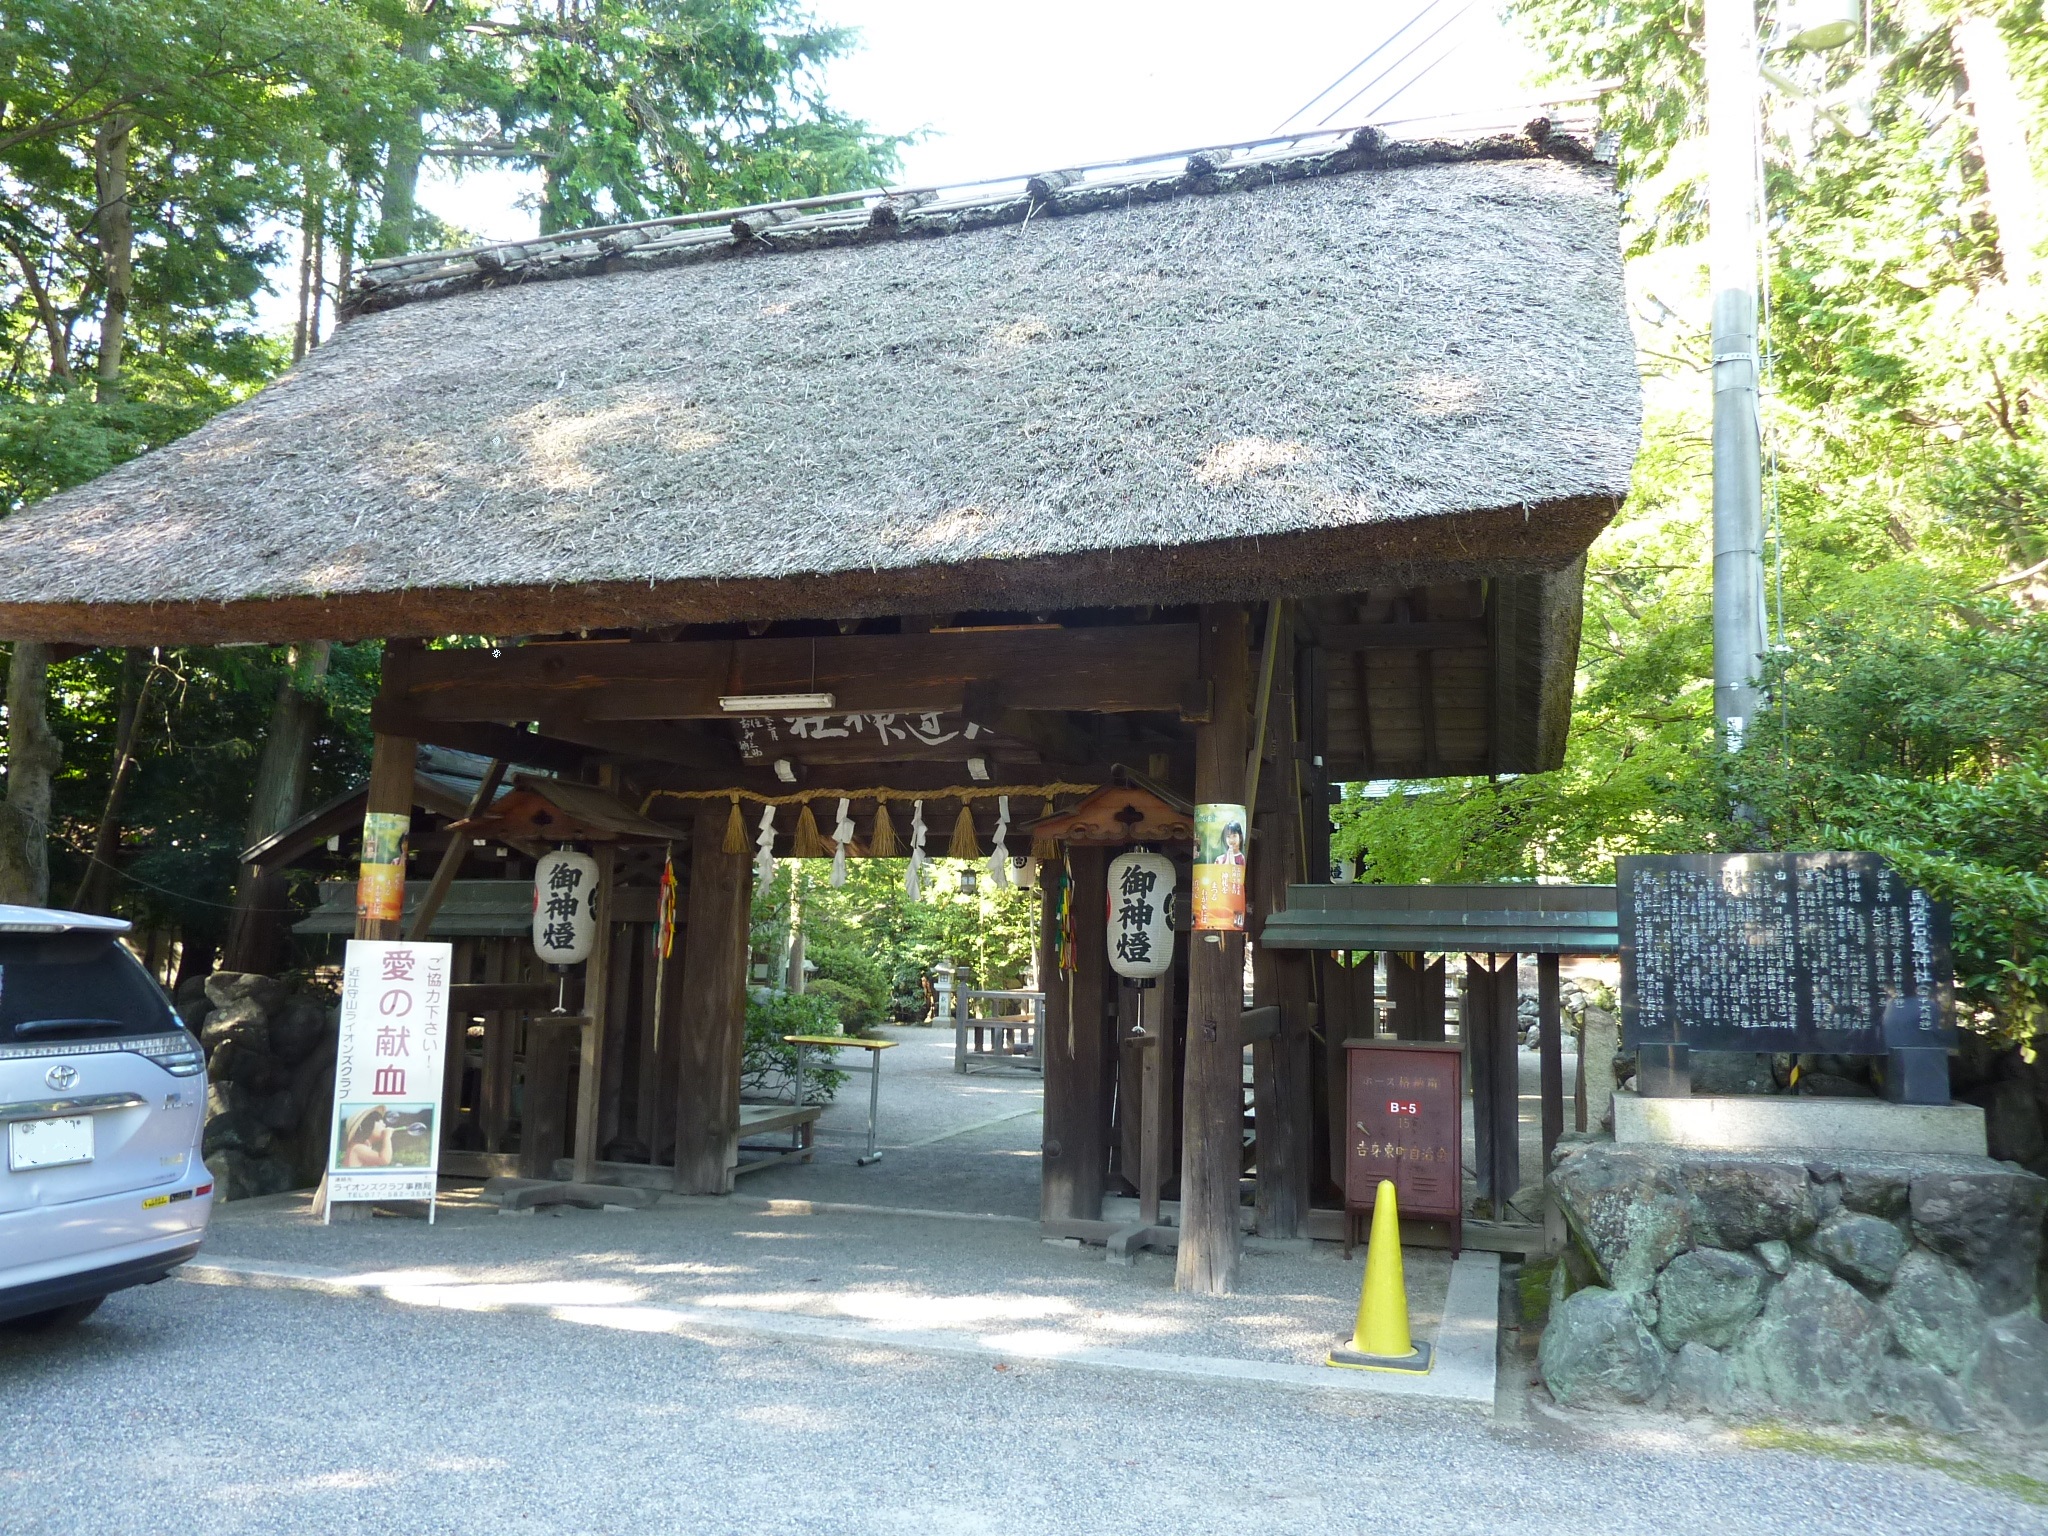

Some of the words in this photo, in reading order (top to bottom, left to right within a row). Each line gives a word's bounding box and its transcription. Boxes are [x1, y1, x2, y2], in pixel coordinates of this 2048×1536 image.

[542, 862, 583, 950] 御神燈
[1116, 864, 1157, 963] 御神燈
[339, 966, 360, 1100] 近江守山ライオンズクラブ
[372, 950, 415, 1095] 愛の献血
[1390, 1102, 1417, 1114] B-5
[334, 1182, 432, 1192] ライオンズクラブ事務局
